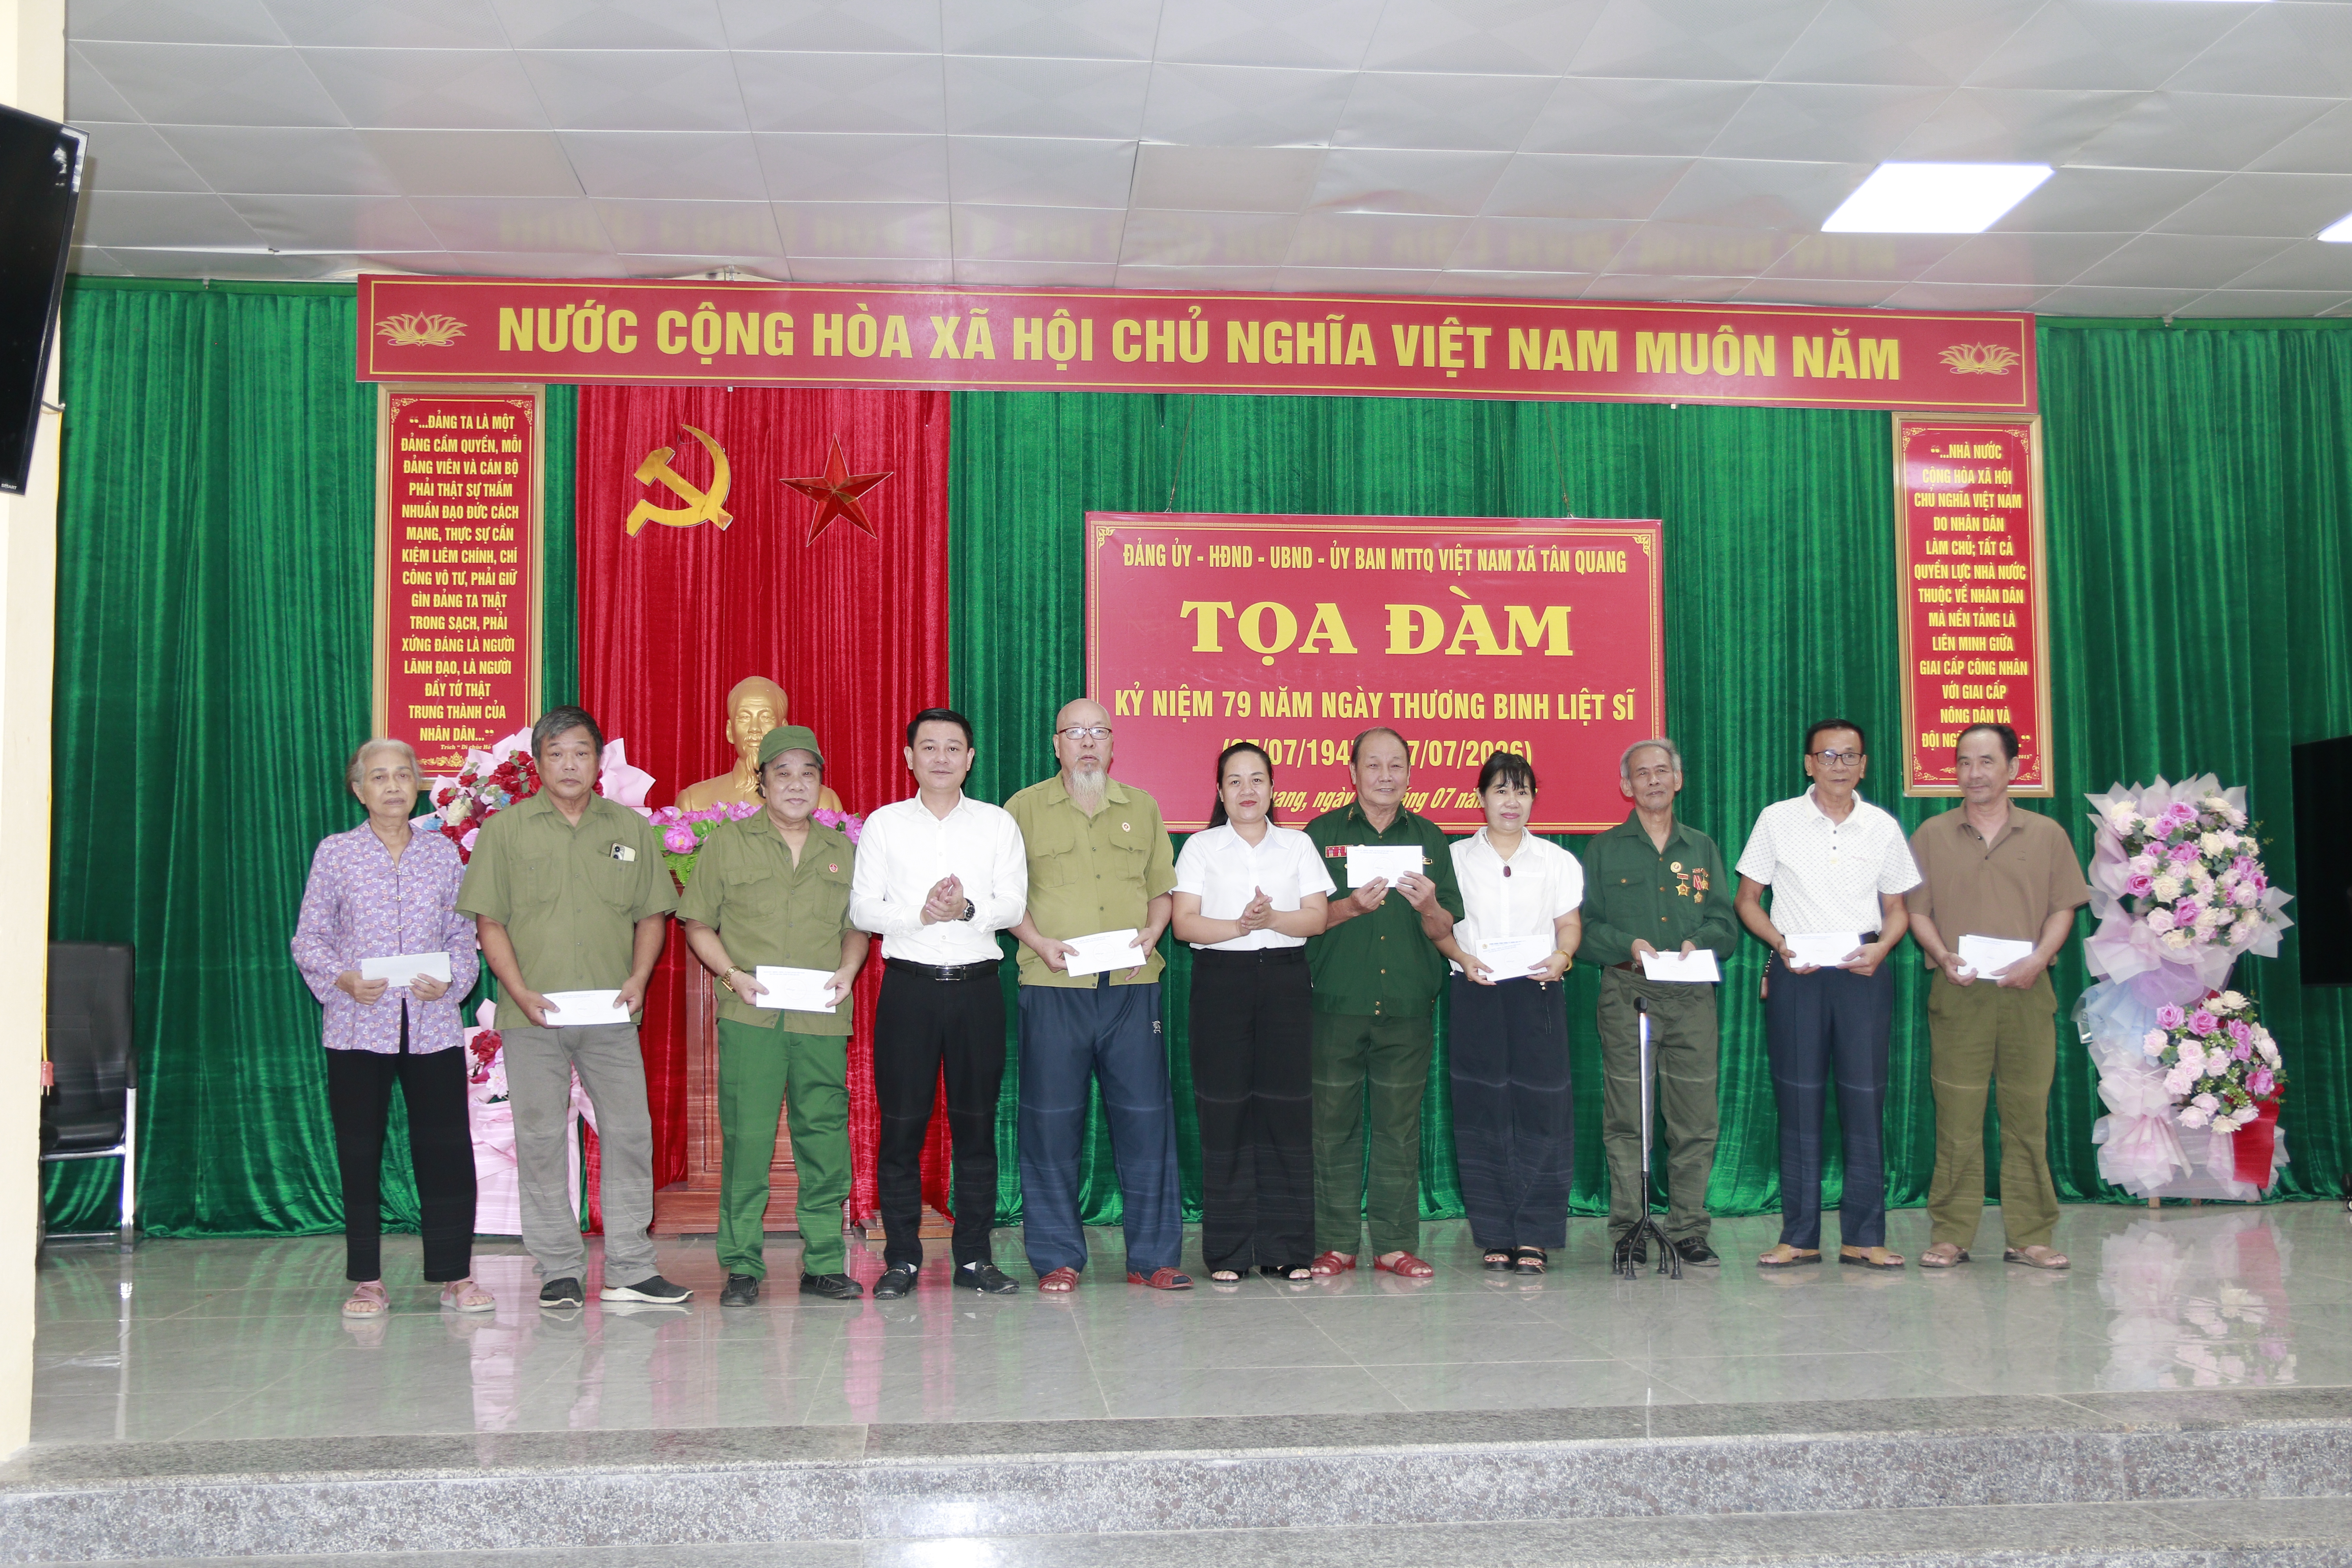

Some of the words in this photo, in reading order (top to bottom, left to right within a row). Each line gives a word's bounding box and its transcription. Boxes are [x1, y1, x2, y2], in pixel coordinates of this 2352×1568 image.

[499, 299, 637, 354] NƯỚC
[657, 302, 794, 365] CỘNG
[813, 303, 912, 358] HÒA
[930, 308, 996, 359] XÃ
[1013, 309, 1093, 370] HỘI
[1112, 305, 1209, 363] CHỦ
[1227, 314, 1376, 365] NGHĨA
[1392, 317, 1492, 377] VIỆT
[1508, 328, 1618, 372] NAM
[1636, 325, 1776, 376] MUÔN
[1793, 328, 1900, 380] NĂM
[460, 416, 473, 429] TA
[476, 414, 489, 429] LÀ
[492, 413, 515, 432] MỘT
[401, 433, 430, 452] ĐẢNG
[434, 435, 457, 452] CẦM
[461, 435, 498, 454] QUYỀN,
[502, 434, 521, 452] MỖI
[1973, 441, 2002, 459] NƯỚC
[403, 455, 433, 474] ĐẢNG
[436, 458, 460, 474] VIÊN
[463, 459, 477, 474] VÀ
[480, 459, 501, 475] CÁN
[505, 459, 518, 477] BỘ
[1923, 466, 1951, 486] CỘNG
[1954, 466, 1976, 483] HÒA
[1978, 467, 1992, 484] XÃ
[1994, 467, 2012, 487] HỘI
[409, 477, 434, 496] PHẢI
[437, 481, 463, 499] THẬT
[466, 483, 482, 499] SỰ
[483, 479, 512, 497] THẤM
[1914, 488, 1935, 507] CHỦ
[1938, 490, 1970, 507] NGHĨA
[1973, 490, 1994, 511] VIỆT
[1997, 494, 2022, 508] NAM
[402, 501, 439, 518] NHUẦN
[442, 505, 463, 521] ĐẠO
[466, 502, 488, 519] ĐỨC
[491, 503, 519, 519] CÁCH
[1933, 516, 1947, 531] DO
[1951, 514, 1980, 531] NHÂN
[1982, 514, 2004, 532] DÂN
[407, 527, 441, 543] MẠNG,
[445, 526, 472, 543] THỰC
[475, 526, 491, 544] SỰ
[492, 524, 514, 541] CẦN
[402, 546, 429, 565] KIỆM
[433, 547, 458, 563] LIÊM
[461, 548, 497, 564] CHÍNH,
[500, 547, 517, 563] CHÍ
[1926, 538, 1948, 555] LÀM
[1951, 535, 1975, 556] CHỦ;
[1978, 537, 1996, 555] TẤT
[1999, 535, 2013, 555] CẢ
[1123, 538, 1166, 566] ĐẢNG
[1172, 538, 1192, 567] ỦY
[1210, 545, 1252, 567] HĐND
[1270, 546, 1312, 568] UBND
[1330, 540, 1350, 569] ỦY
[1356, 548, 1386, 569] BAN
[1392, 548, 1434, 573] MTTQ
[1438, 543, 1473, 575] VIỆT
[1477, 549, 1512, 571] NAM
[1517, 545, 1537, 572] XÃ
[1541, 545, 1570, 572] TÂN
[1575, 550, 1627, 575] QUANG
[403, 568, 432, 585] CÔNG
[435, 569, 448, 585] VÔ
[452, 571, 468, 586] TƯ,
[471, 566, 495, 585] PHẢI
[499, 569, 517, 585] GIỮ
[1914, 559, 1948, 580] QUYỀN
[1951, 563, 1971, 582] LỰC
[1974, 563, 1995, 579] NHÀ
[1998, 561, 2026, 580] NƯỚC
[412, 591, 430, 607] GÌN
[433, 588, 463, 607] ĐẢNG
[466, 594, 479, 607] TA
[481, 592, 507, 610] THẬT
[1918, 585, 1952, 606] THUỘC
[1955, 584, 1967, 603] VỀ
[1971, 586, 2000, 603] NHÂN
[2002, 586, 2024, 603] DÂN
[410, 616, 445, 630] TRONG
[448, 616, 480, 632] SẠCH,
[483, 611, 507, 630] PHẢI
[1180, 601, 1358, 666] TỌA
[1385, 586, 1574, 656] ĐÀM
[1929, 610, 1946, 626] MÀ
[1948, 608, 1970, 627] NỀN
[1973, 607, 2000, 627] TẢNG
[2003, 610, 2016, 627] LÀ
[402, 635, 431, 652] XỨNG
[434, 636, 464, 652] ĐÁNG
[467, 637, 479, 652] LÀ
[483, 635, 514, 652] NGƯỜI
[1933, 633, 1955, 651] LIÊN
[1958, 637, 1986, 651] MINH
[1989, 633, 2013, 651] GIỮA
[405, 658, 432, 674] LÃNH
[436, 661, 460, 677] ĐẠO,
[463, 659, 476, 674] LÀ
[479, 658, 511, 674] NGƯỜI
[1920, 660, 1940, 675] GIAI
[1944, 656, 1964, 675] CẤP
[1968, 658, 1996, 675] CÔNG
[1999, 658, 2027, 675] NHÂN
[425, 679, 446, 696] ĐẦY
[449, 680, 463, 697] TỚ
[465, 681, 491, 699] THẬT
[1942, 681, 1959, 699] VỚI
[1962, 684, 1983, 699] GIAI
[1986, 680, 2006, 699] CẤP
[408, 705, 444, 719] TRUNG
[447, 703, 482, 719] THÀNH
[485, 700, 506, 719] CỦA
[1116, 681, 1144, 716] KỶ
[1153, 684, 1213, 722] NIỆM
[1222, 691, 1251, 717] 79
[1260, 686, 1312, 717] NĂM
[1322, 686, 1383, 718] NGÀY
[1390, 689, 1485, 719] THƯƠNG
[1494, 693, 1549, 719] BINH
[1558, 688, 1606, 726] LIỆT
[1613, 688, 1635, 720] SĨ
[1940, 706, 1969, 723] NÔNG
[1973, 706, 1994, 723] DÂN
[1996, 706, 2010, 723] VÀ
[420, 725, 450, 741] NHÂN
[1922, 730, 1939, 750] ĐỘI
[1942, 730, 1962, 748] NG
[1273, 791, 1307, 812] ang,
[1430, 788, 1457, 808] 07
[1454, 788, 1483, 808] nă
